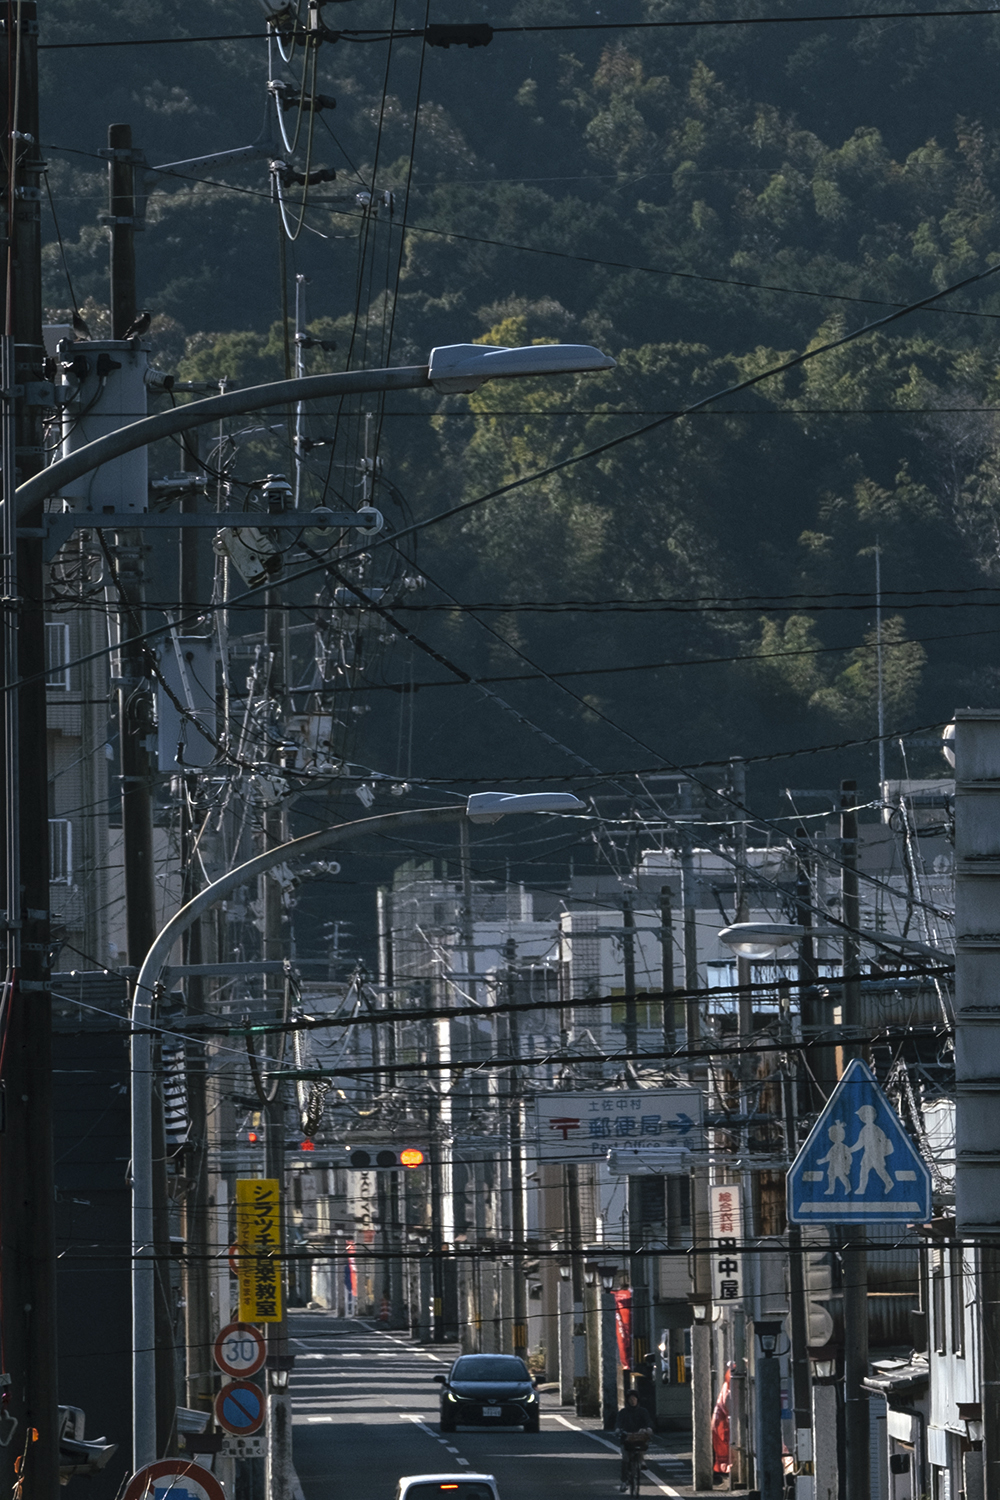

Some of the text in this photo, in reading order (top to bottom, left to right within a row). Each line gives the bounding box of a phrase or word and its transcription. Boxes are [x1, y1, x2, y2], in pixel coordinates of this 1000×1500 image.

[588, 1099, 642, 1111] 土佐中村
[588, 1115, 662, 1138] 郵便局
[718, 1236, 739, 1300] 田中屋
[226, 1338, 255, 1362] 30
